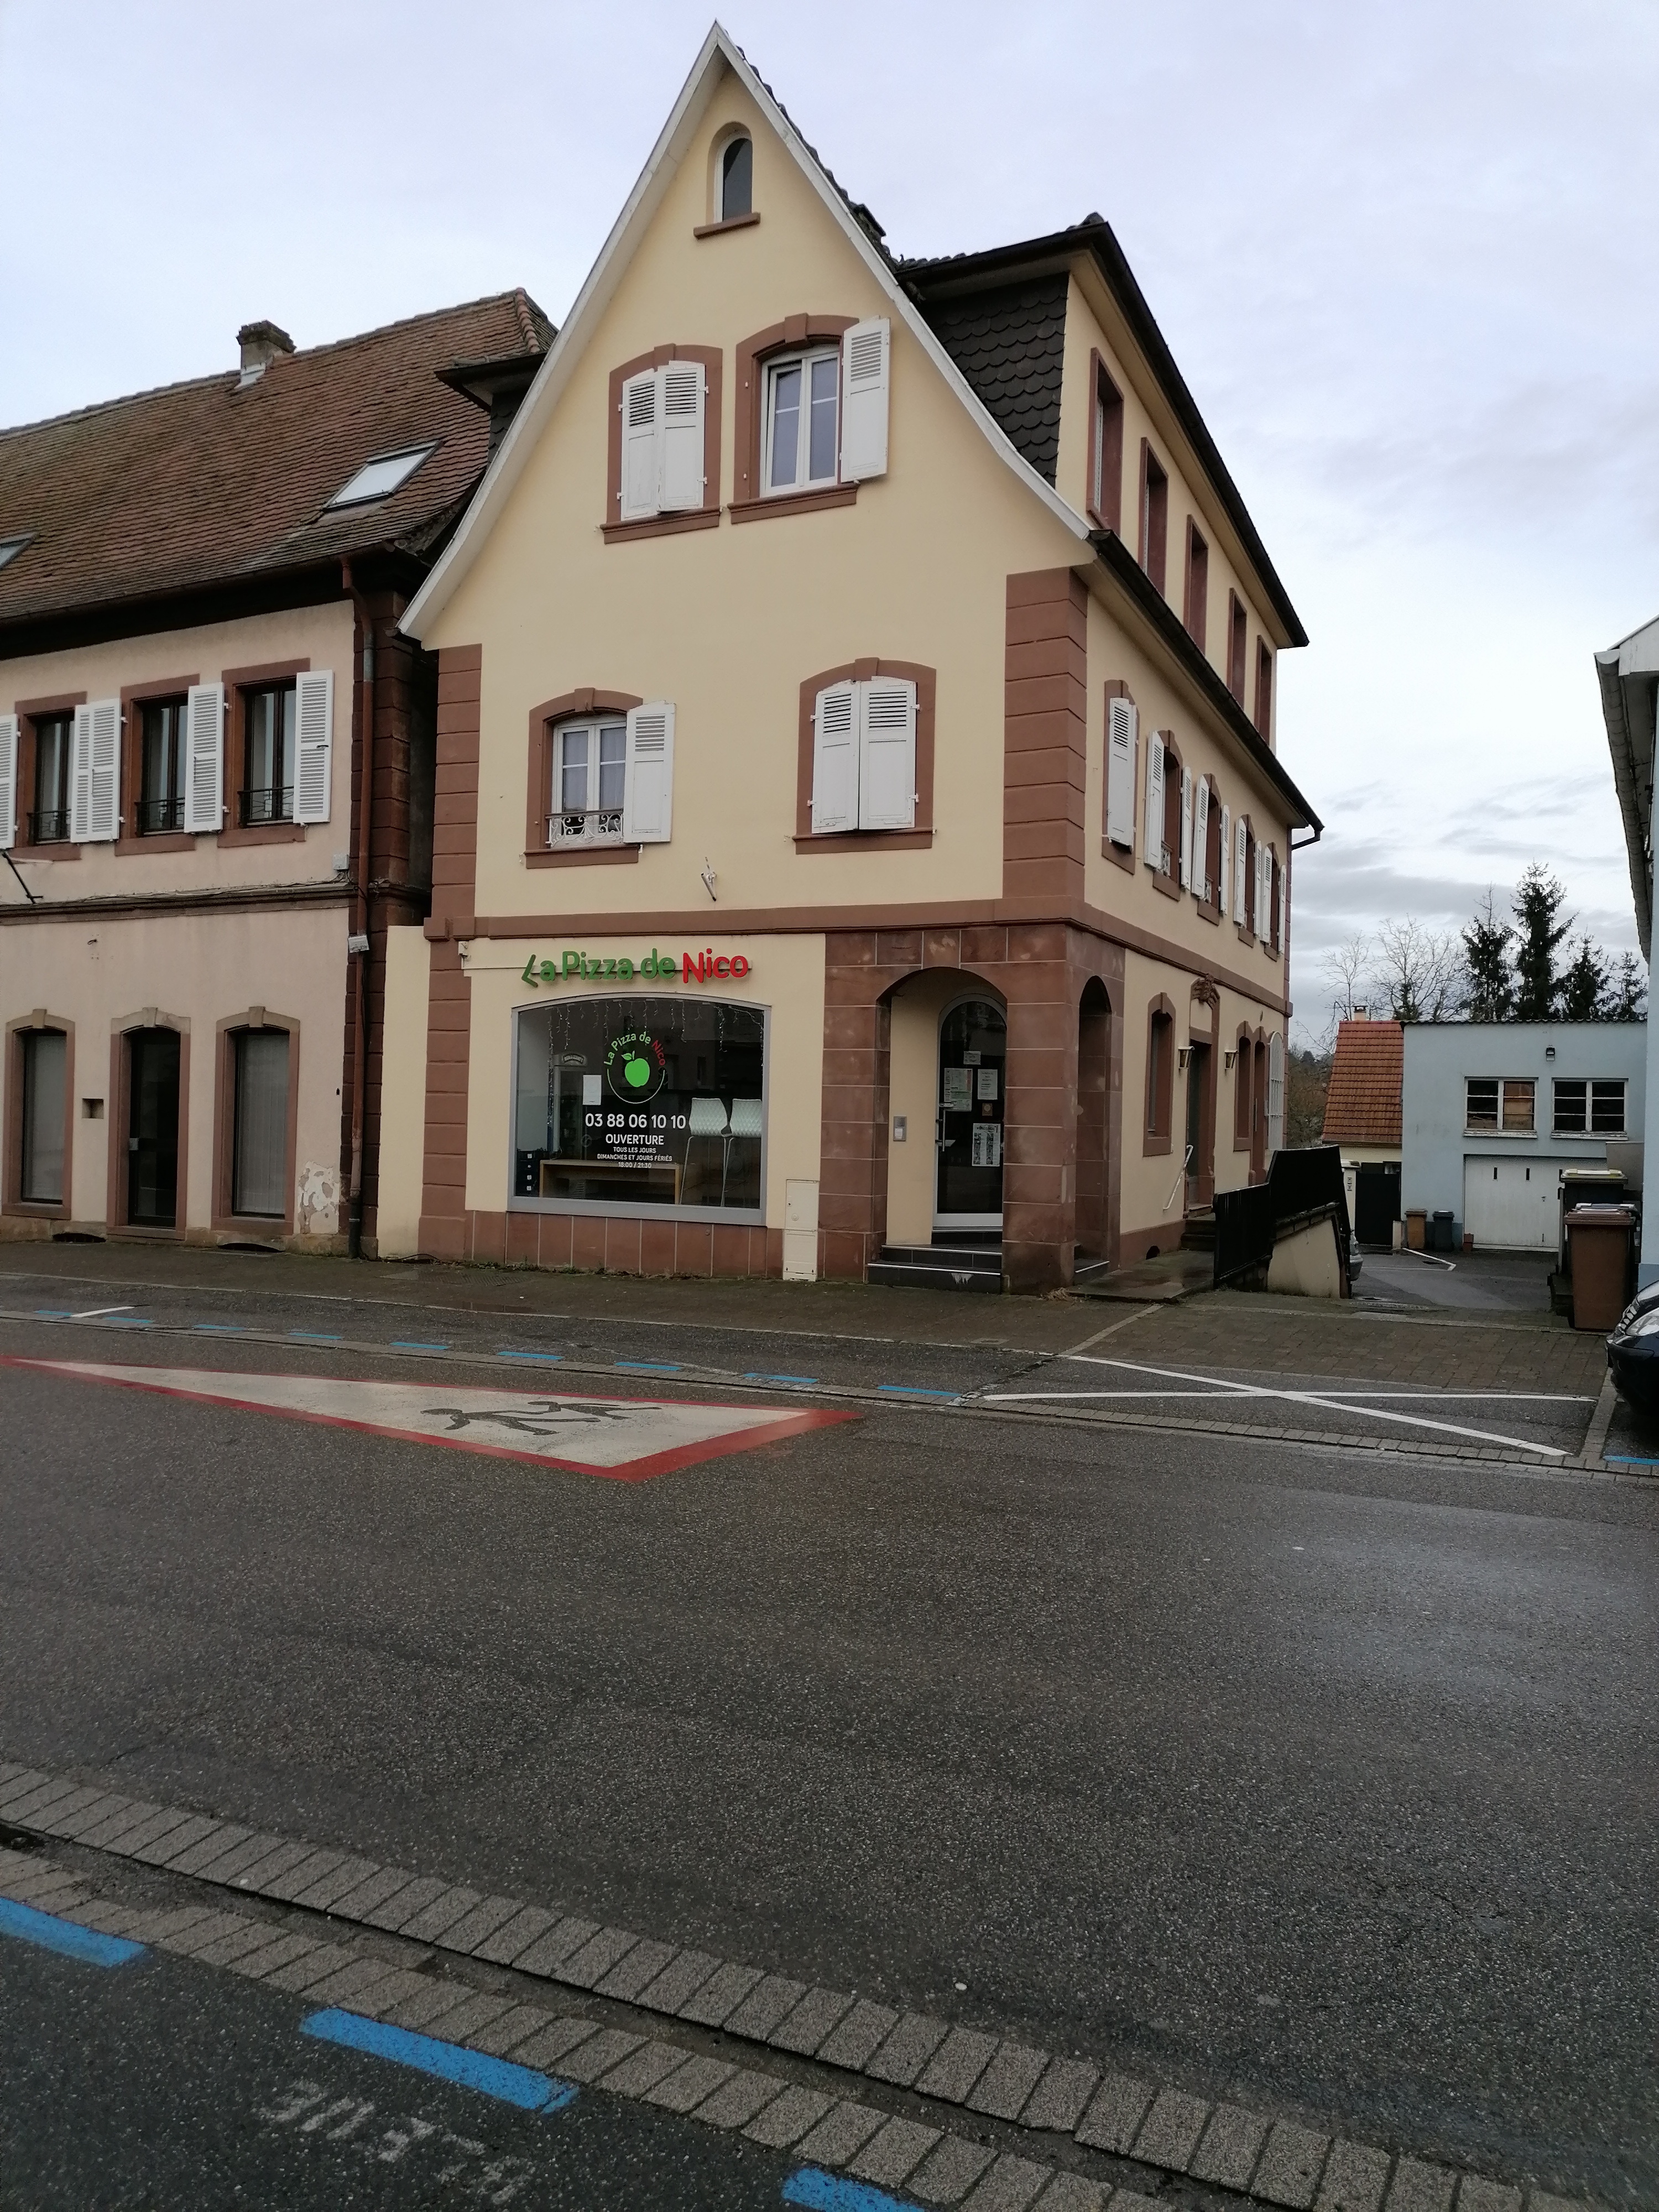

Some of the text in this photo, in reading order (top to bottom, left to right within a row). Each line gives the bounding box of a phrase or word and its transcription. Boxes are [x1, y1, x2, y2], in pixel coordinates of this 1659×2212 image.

[521, 947, 749, 988] La Pizza de Nico
[603, 1051, 615, 1066] La
[611, 1033, 637, 1051] Pizza
[639, 1031, 651, 1044] de
[651, 1040, 666, 1066] Nico
[585, 1113, 686, 1129] 03 88 06 10 10
[606, 1134, 665, 1145] OUVERTURE
